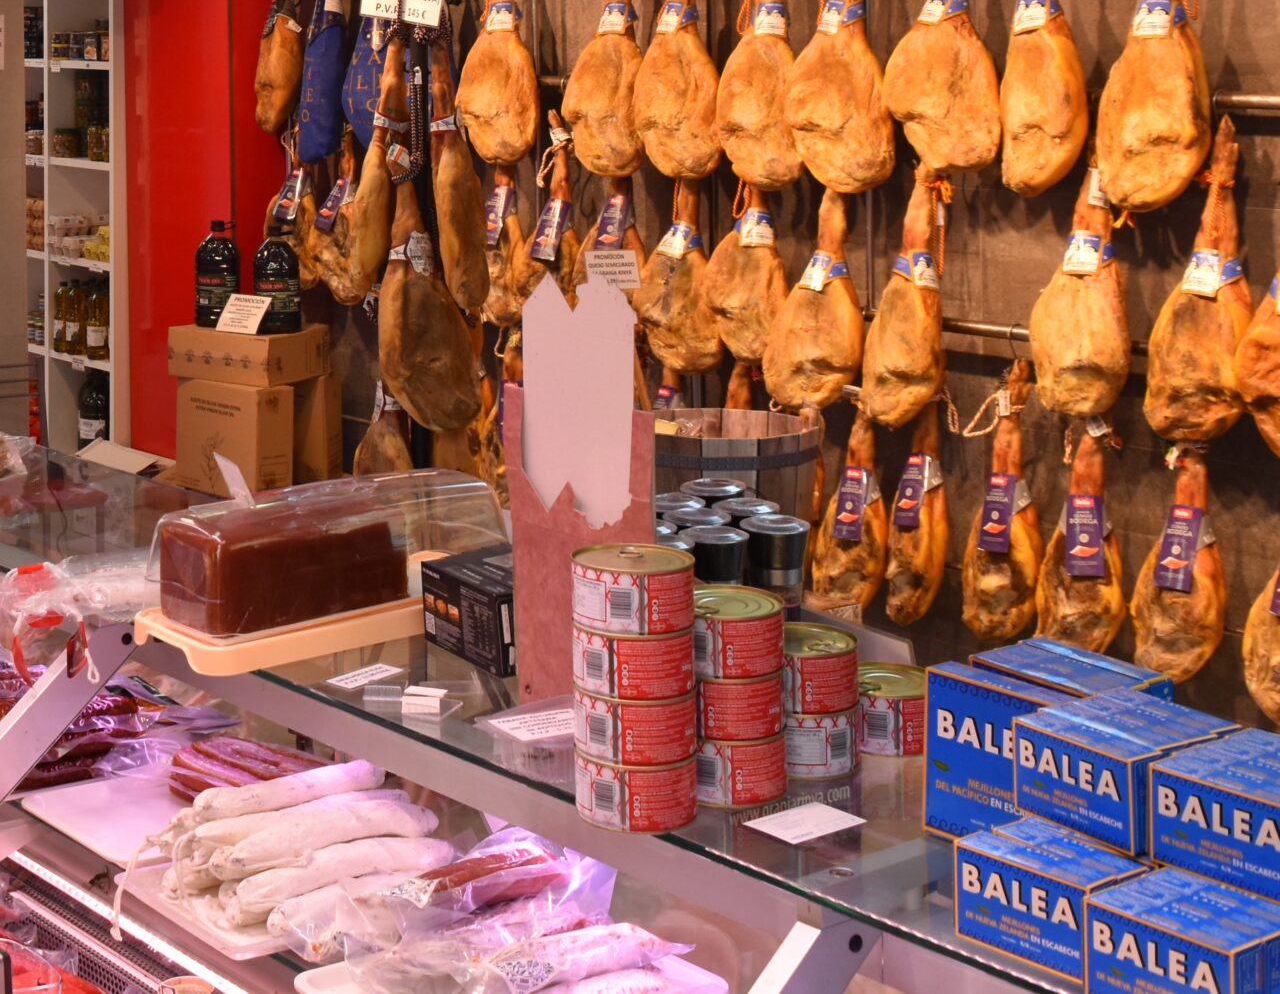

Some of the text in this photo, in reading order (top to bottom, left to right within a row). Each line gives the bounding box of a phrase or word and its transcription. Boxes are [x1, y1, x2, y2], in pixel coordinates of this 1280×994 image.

[408, 8, 419, 19] 145
[937, 706, 1014, 761] BALE
[1019, 737, 1122, 803] BALEA
[935, 778, 950, 793] DEL
[990, 797, 1002, 810] EN
[1079, 806, 1088, 816] EN
[1088, 808, 1124, 831] ESCABECHE
[1158, 783, 1280, 854] BALEA
[1232, 857, 1243, 869] EN
[962, 861, 1080, 932] BALEA
[1030, 934, 1041, 944] EN
[1041, 937, 1080, 960] ESCABECHE
[1093, 918, 1222, 994] BALEA
